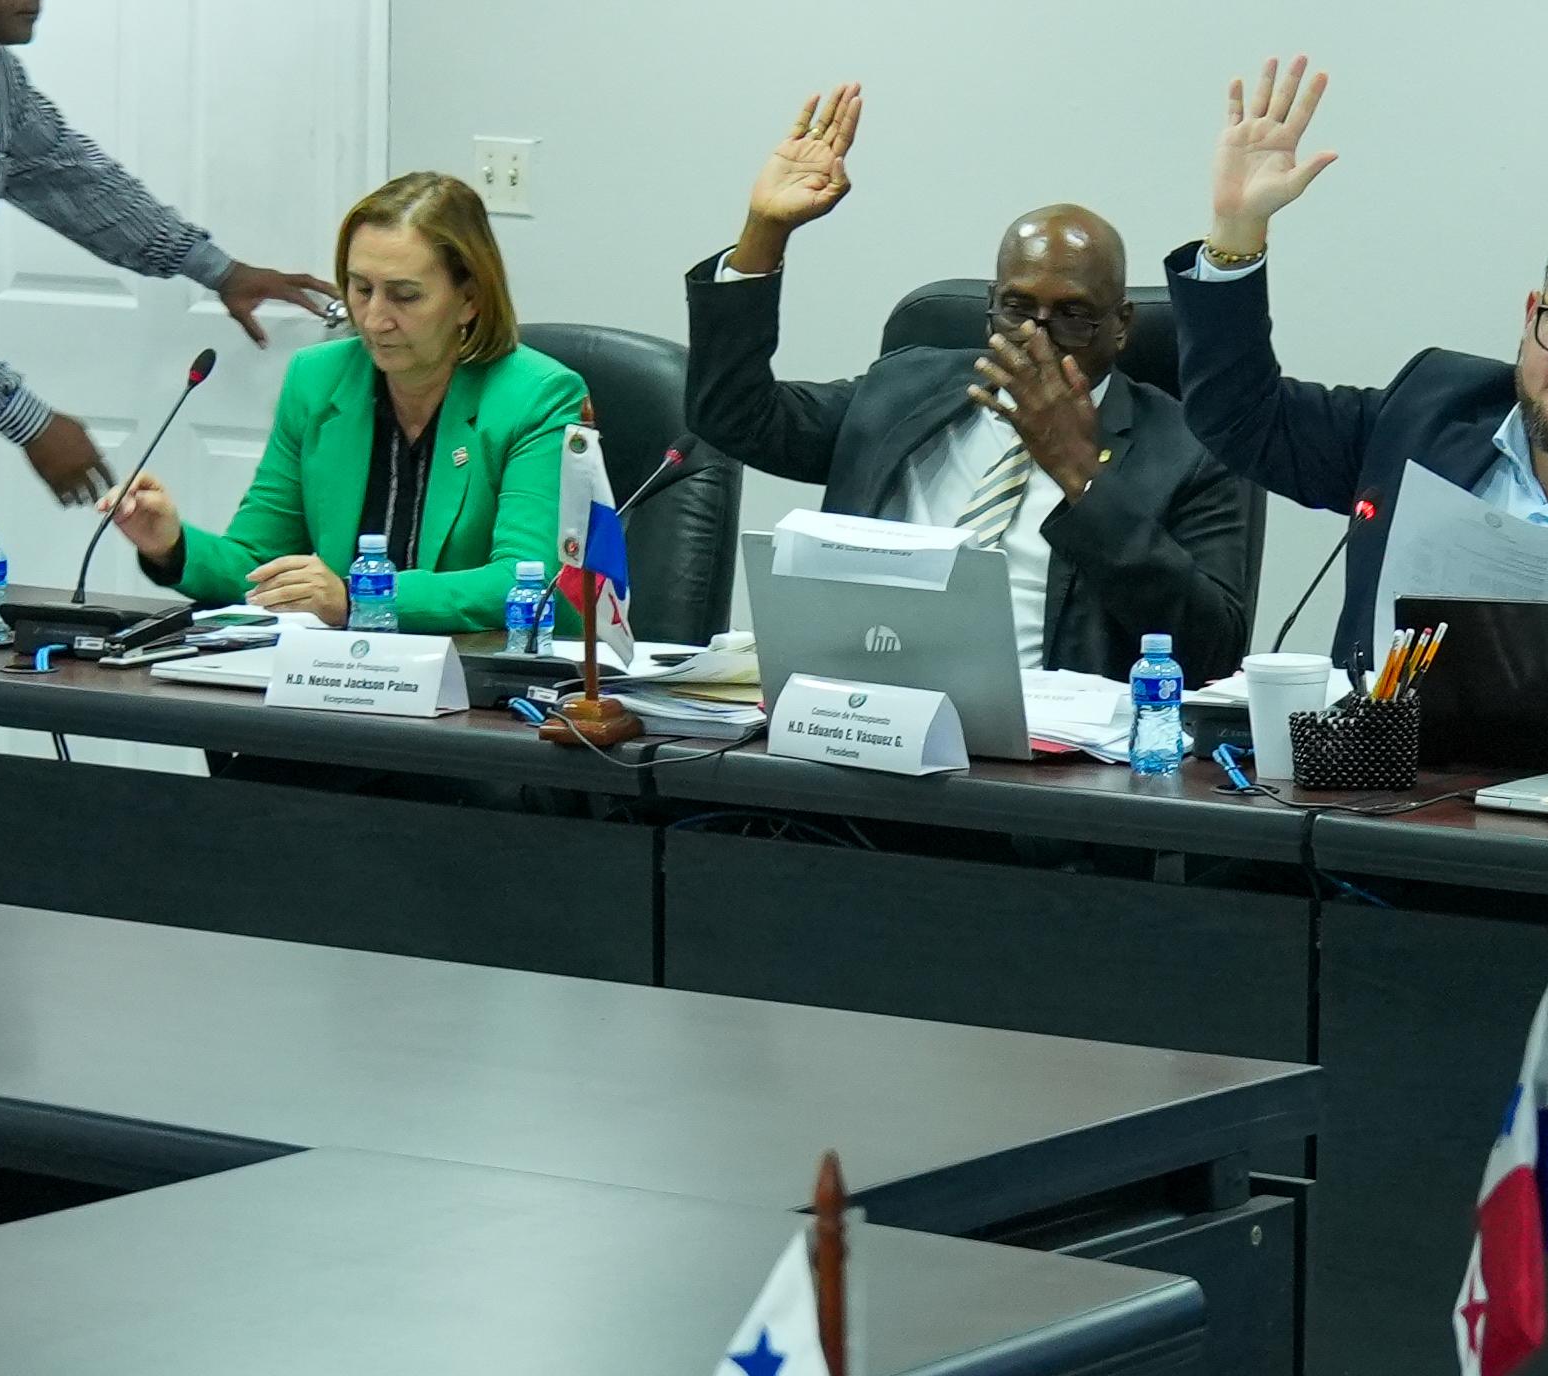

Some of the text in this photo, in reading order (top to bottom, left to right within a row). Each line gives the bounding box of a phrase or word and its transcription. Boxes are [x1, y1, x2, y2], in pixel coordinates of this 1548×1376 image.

[357, 662, 400, 673] Presupuesto
[286, 674, 419, 693] H.D. Nelson Jackson Palma
[323, 694, 375, 706] Vicepresidente
[843, 711, 850, 719] de
[851, 712, 891, 726] Presupuesto
[787, 720, 805, 734] H.D.
[808, 723, 843, 740] Eduardo
[846, 729, 853, 740] E.
[895, 736, 904, 748] G.
[826, 746, 860, 759] Presidente
